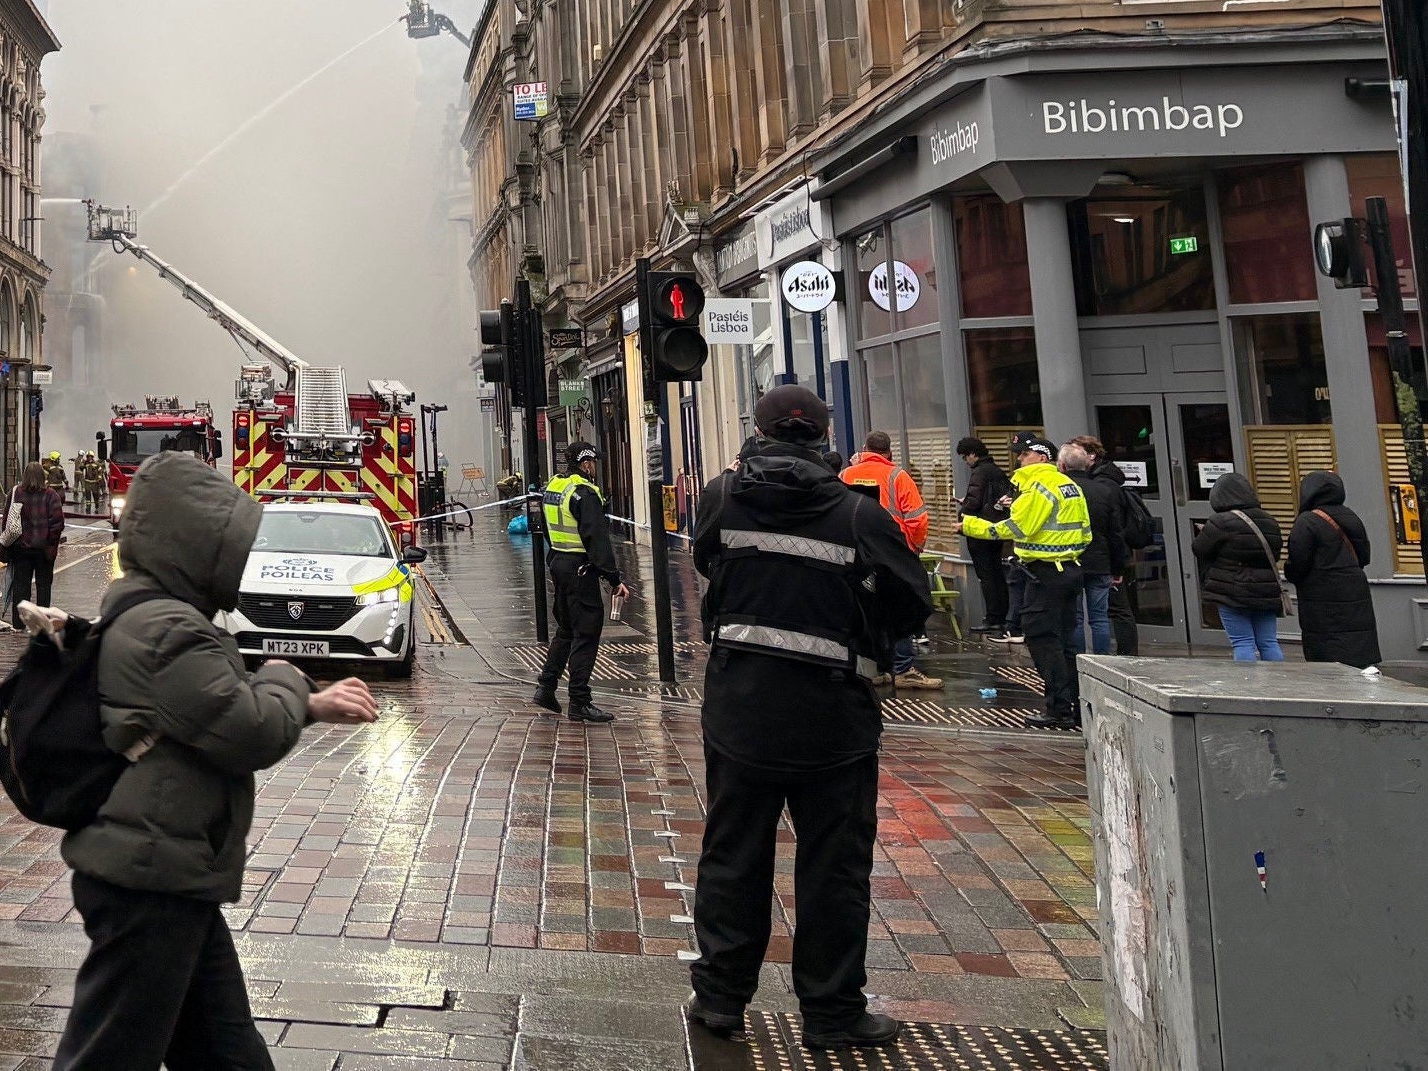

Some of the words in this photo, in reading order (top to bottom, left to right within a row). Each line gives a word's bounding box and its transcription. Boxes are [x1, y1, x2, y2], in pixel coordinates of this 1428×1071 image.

[515, 84, 530, 95] TO
[535, 83, 547, 94] LE
[1042, 96, 1244, 137] Bibimbap
[930, 120, 979, 165] Bibimbap
[788, 274, 829, 293] Asahi
[709, 310, 749, 322] Pastéis
[711, 321, 748, 333] Lisboa
[262, 565, 334, 573] POLICE
[260, 572, 334, 581] POILEAS
[267, 641, 298, 653] MT23
[301, 642, 324, 655] XPK
